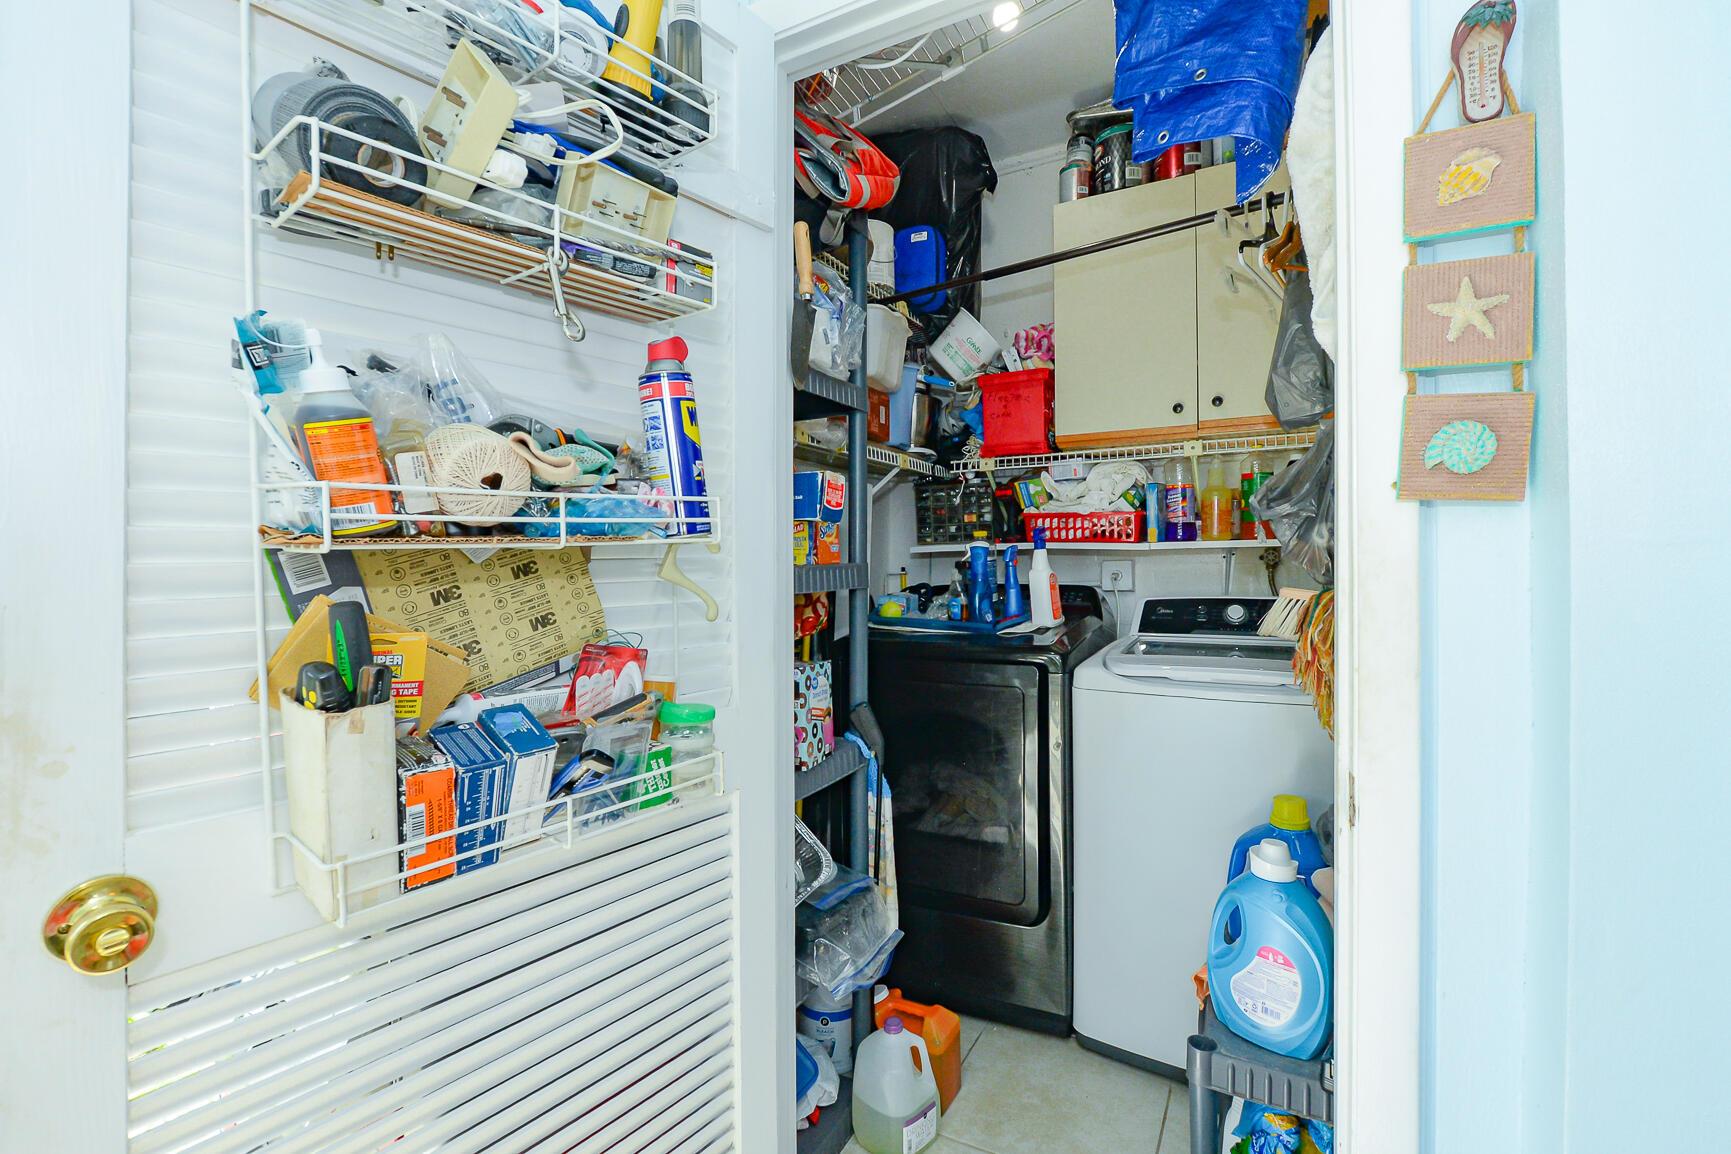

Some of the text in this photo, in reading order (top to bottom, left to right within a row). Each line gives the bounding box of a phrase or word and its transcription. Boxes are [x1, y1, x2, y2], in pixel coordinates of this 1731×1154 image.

[510, 560, 539, 580] 3M
[430, 585, 462, 606] 3M
[529, 612, 557, 632] 3M
